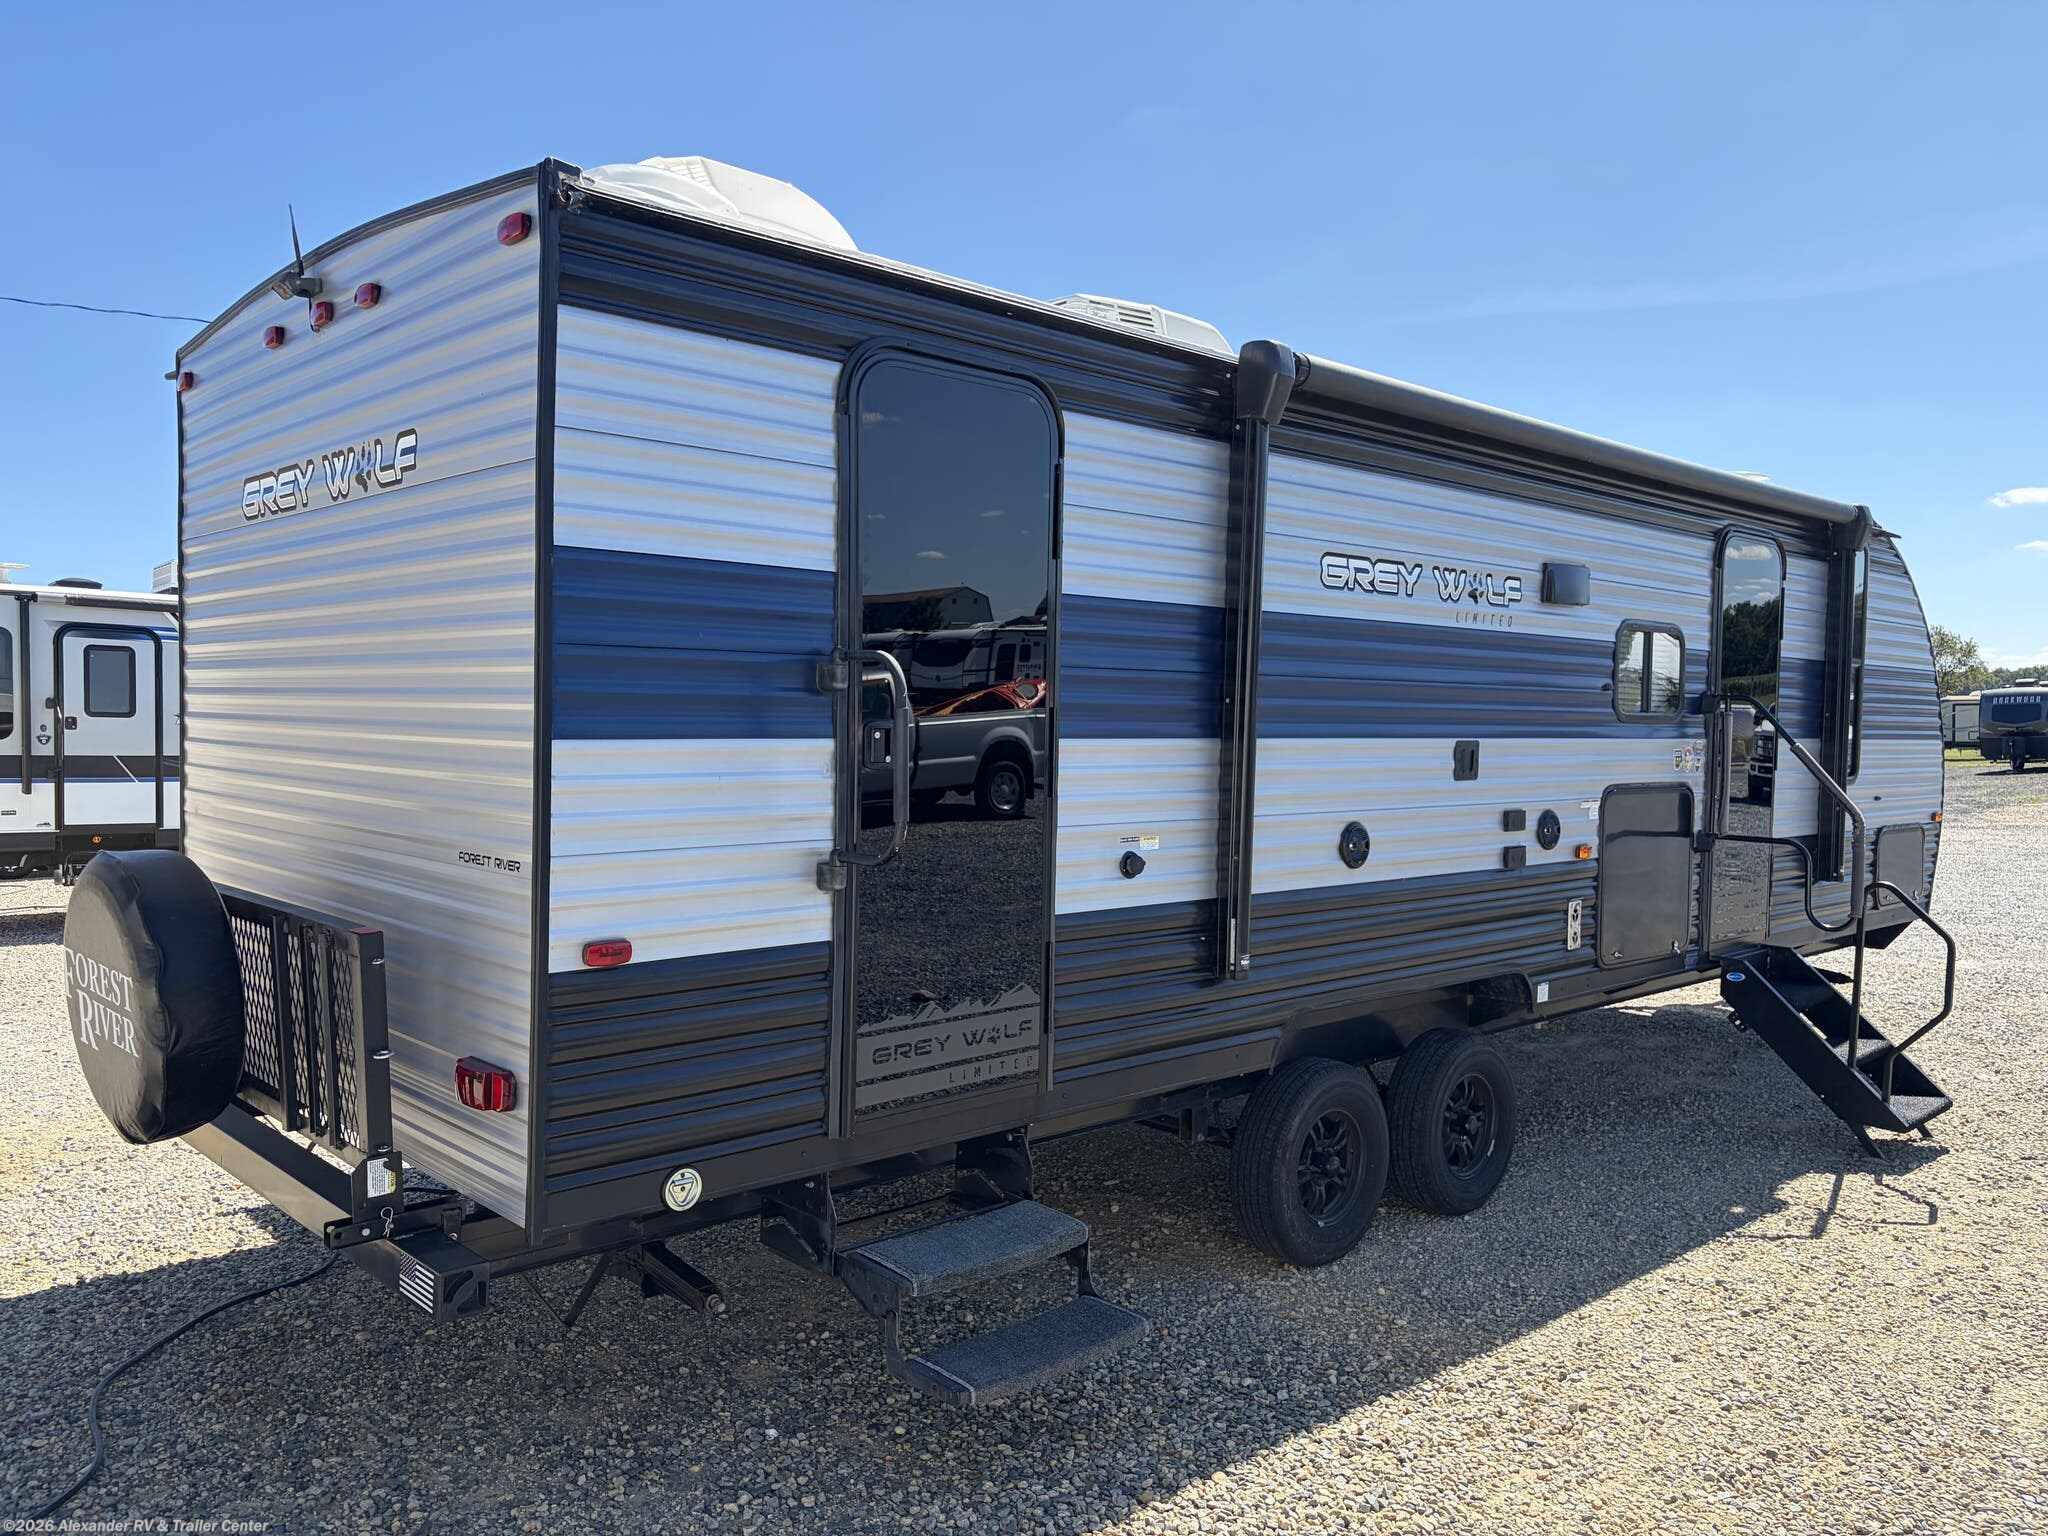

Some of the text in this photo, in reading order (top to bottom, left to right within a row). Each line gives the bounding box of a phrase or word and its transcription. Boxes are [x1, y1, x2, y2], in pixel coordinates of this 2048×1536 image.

[242, 428, 417, 521] GREY WLF
[1320, 551, 1523, 608] GREY WLF
[1455, 611, 1513, 628] LIMITED
[458, 851, 522, 873] FOREST RIVER
[63, 945, 134, 1013] FOREST
[76, 988, 140, 1059] RIVER
[872, 1018, 1034, 1066] GREY WLF
[949, 1055, 1034, 1084] LIMITED
